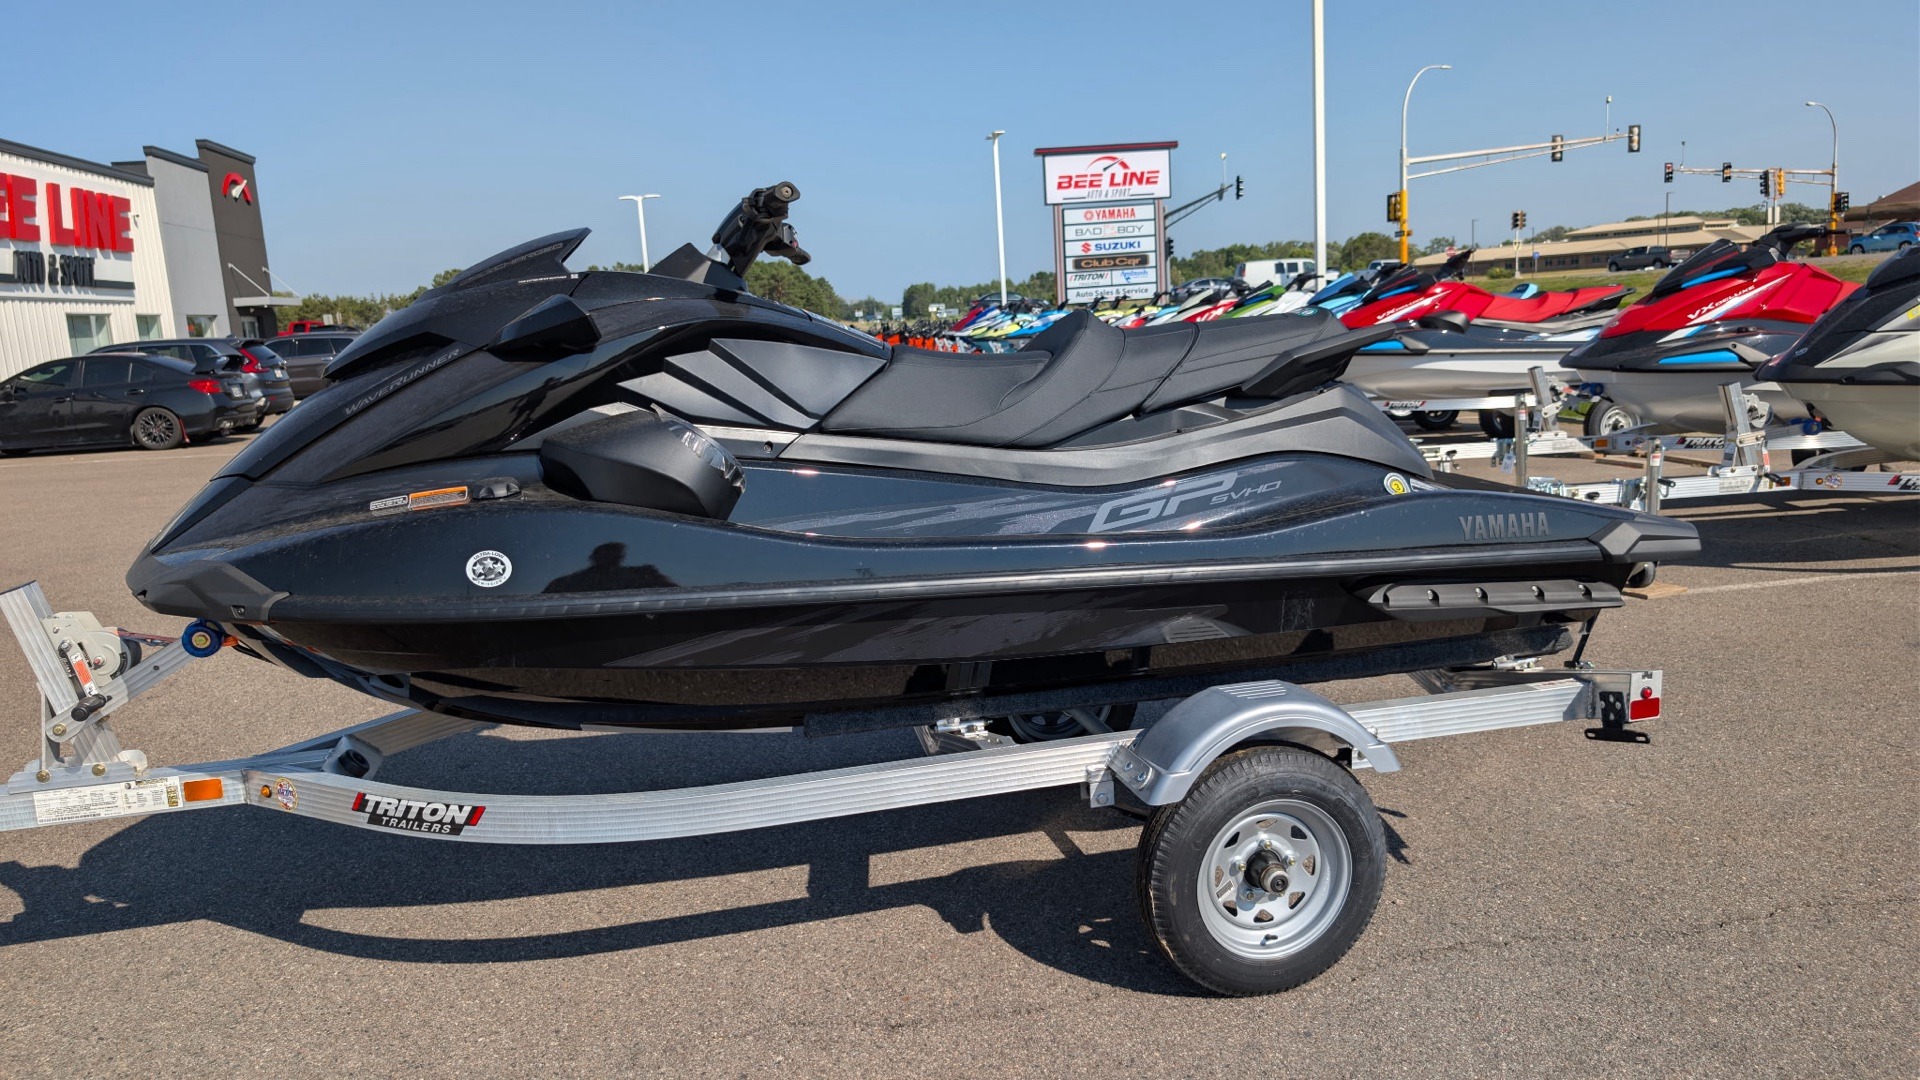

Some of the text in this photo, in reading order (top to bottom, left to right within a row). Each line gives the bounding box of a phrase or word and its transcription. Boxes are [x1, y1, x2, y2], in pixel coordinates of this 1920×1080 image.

[1056, 170, 1160, 190] BEE LINE
[1087, 188, 1131, 199] AUTO & SPORT
[46, 182, 134, 254] LINE
[1095, 208, 1136, 220] YAMAHA
[1075, 225, 1144, 236] BAD BOY
[1095, 241, 1140, 251] SUZUKI
[13, 250, 46, 285] AUTO
[60, 254, 95, 287] SPORT
[1080, 257, 1142, 268] Club Car
[1073, 273, 1105, 281] TRITON
[1095, 289, 1114, 297] Sales
[1123, 287, 1149, 295] Service
[1687, 302, 1715, 319] VX
[345, 348, 460, 415] WAVERUNNER
[1087, 472, 1238, 533] GP
[1459, 512, 1550, 541] YAMAHA
[364, 793, 473, 825] TRITON
[381, 816, 452, 834] TRAILERS
